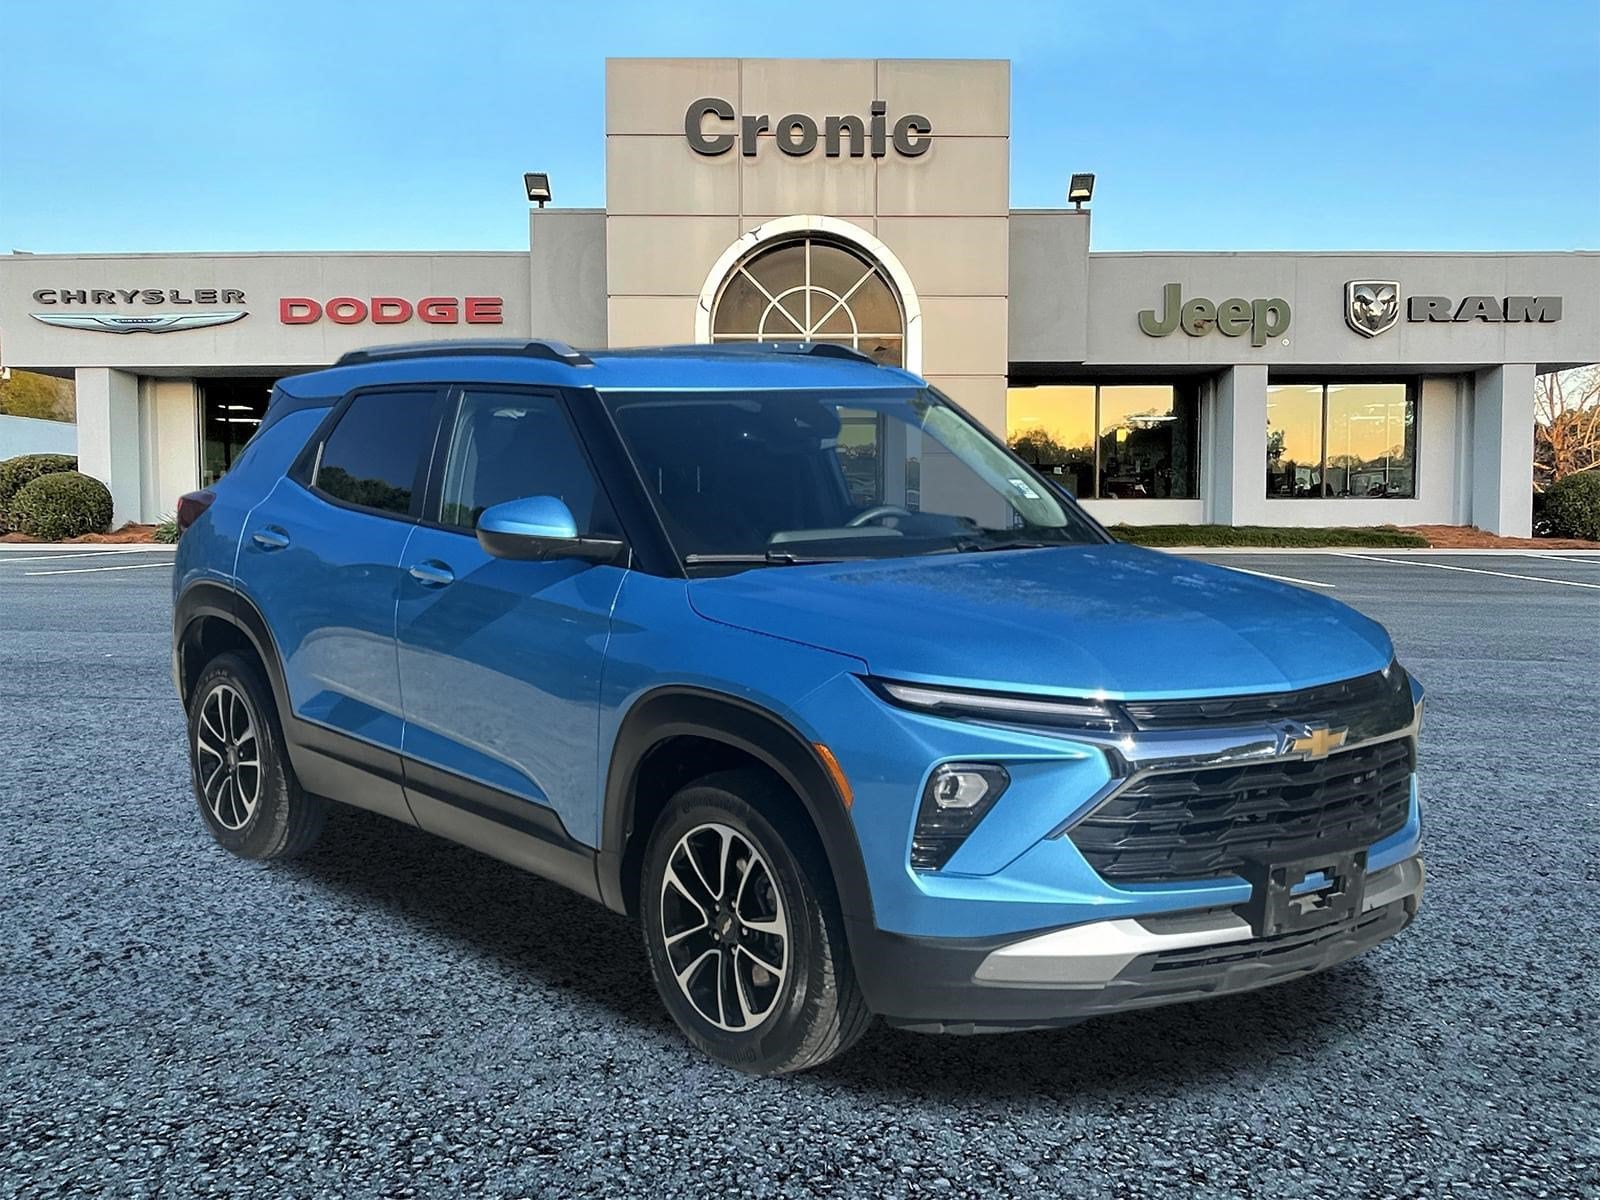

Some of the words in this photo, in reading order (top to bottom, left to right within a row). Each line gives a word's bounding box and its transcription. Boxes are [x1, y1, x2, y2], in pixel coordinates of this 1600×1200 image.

[685, 97, 932, 157] Cronic
[32, 289, 247, 304] CHRYSLER
[1407, 296, 1563, 322] RAM
[280, 297, 503, 325] DODGE
[1138, 283, 1291, 347] Jeep
